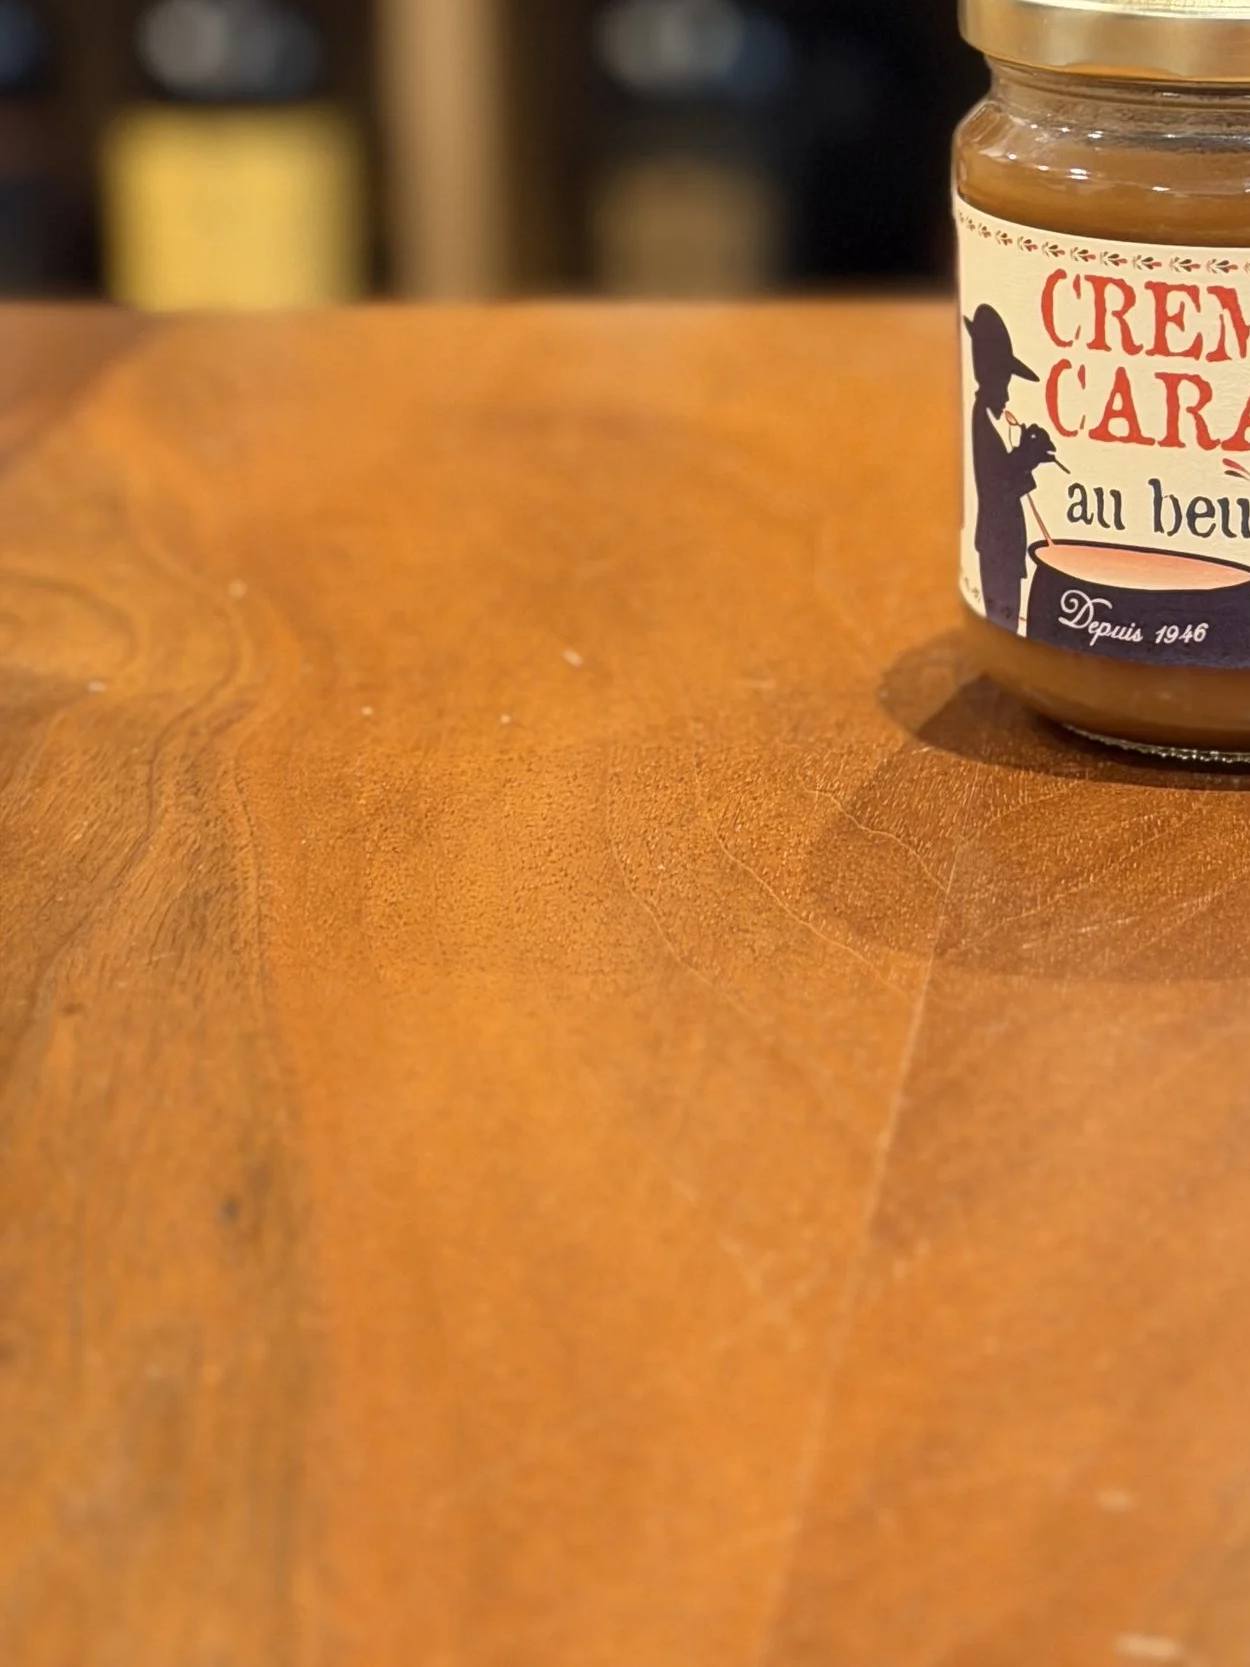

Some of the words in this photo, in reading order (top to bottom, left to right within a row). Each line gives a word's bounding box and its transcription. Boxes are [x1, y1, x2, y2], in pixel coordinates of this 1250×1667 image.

[1066, 482, 1126, 530] au
[1058, 589, 1144, 646] Depuis
[1155, 623, 1209, 644] 1946
